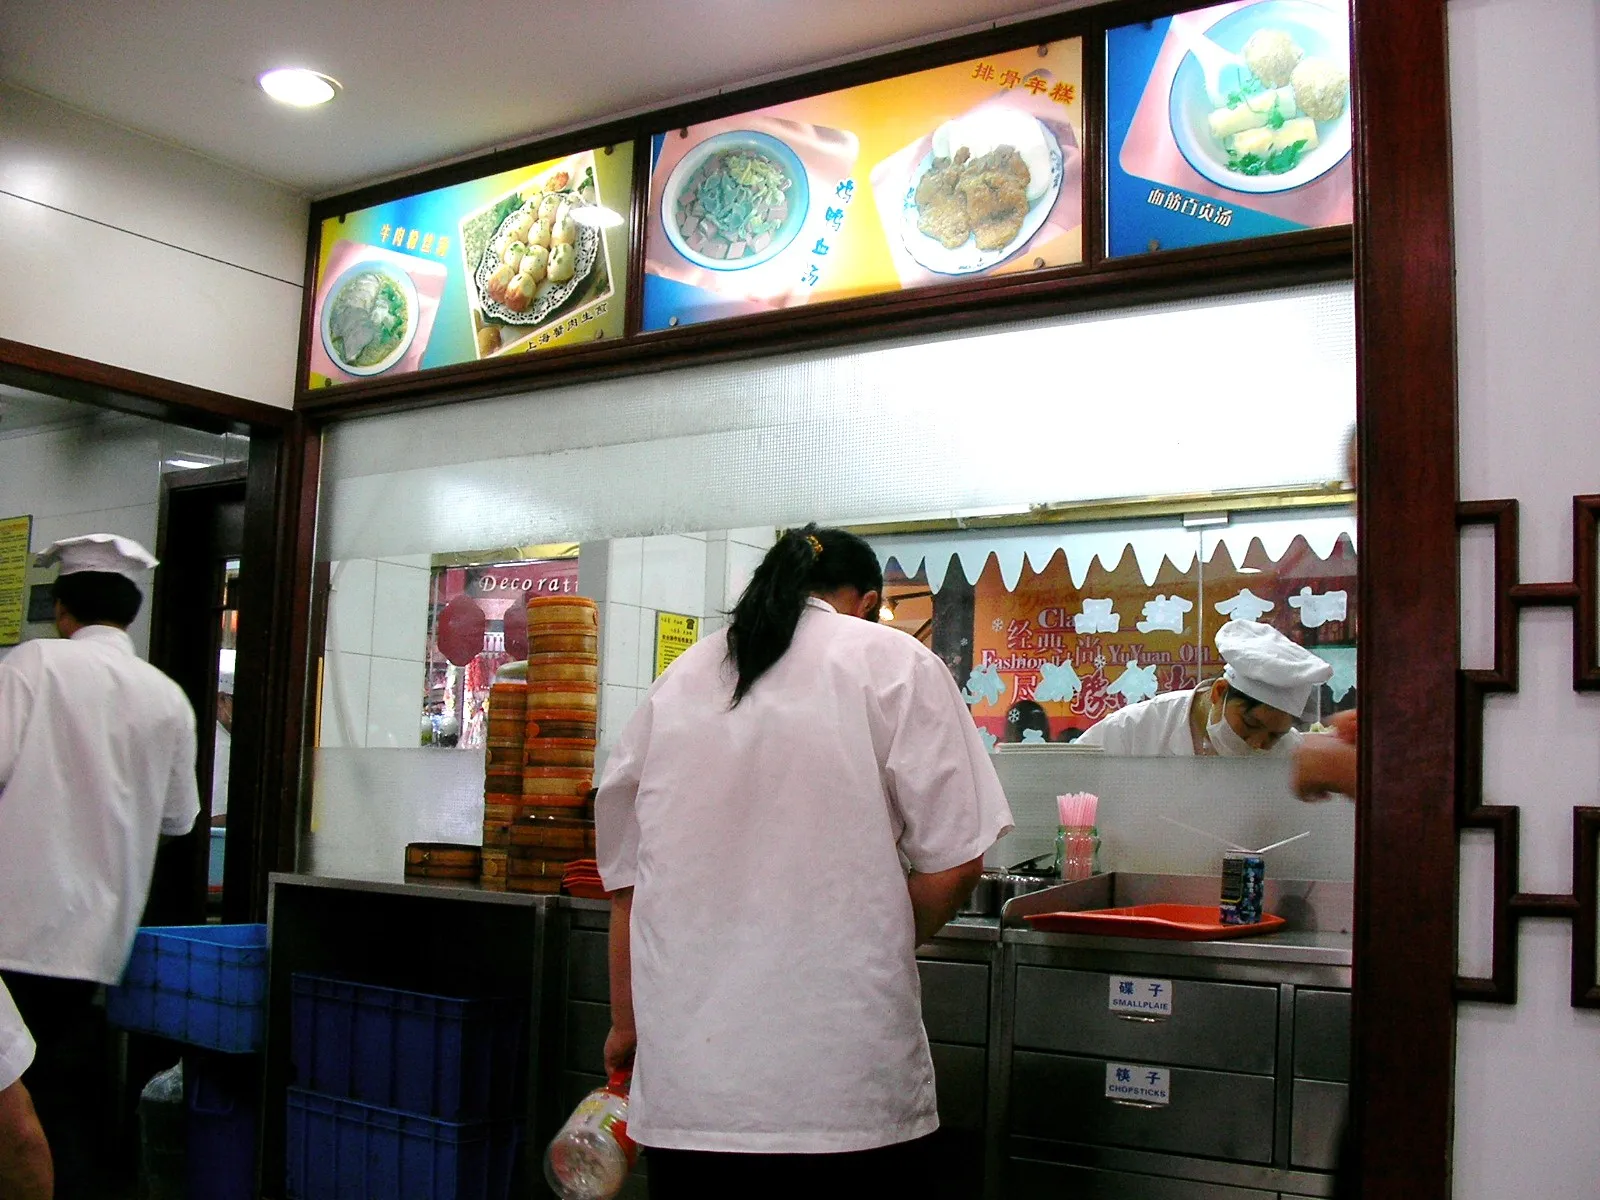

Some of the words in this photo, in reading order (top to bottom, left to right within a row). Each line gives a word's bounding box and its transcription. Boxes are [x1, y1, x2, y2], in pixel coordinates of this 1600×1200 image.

[971, 62, 1074, 104] 排骨年糕
[801, 179, 854, 287] 鸡鸭血汤
[526, 302, 608, 352] 上海蟹肉生煎
[981, 649, 1047, 671] Fashion
[1108, 644, 1172, 664] YuYuan
[1119, 981, 1164, 998] 碟子
[1116, 1067, 1160, 1085] 筷子
[1108, 1084, 1167, 1097] CHOPSTICKS
